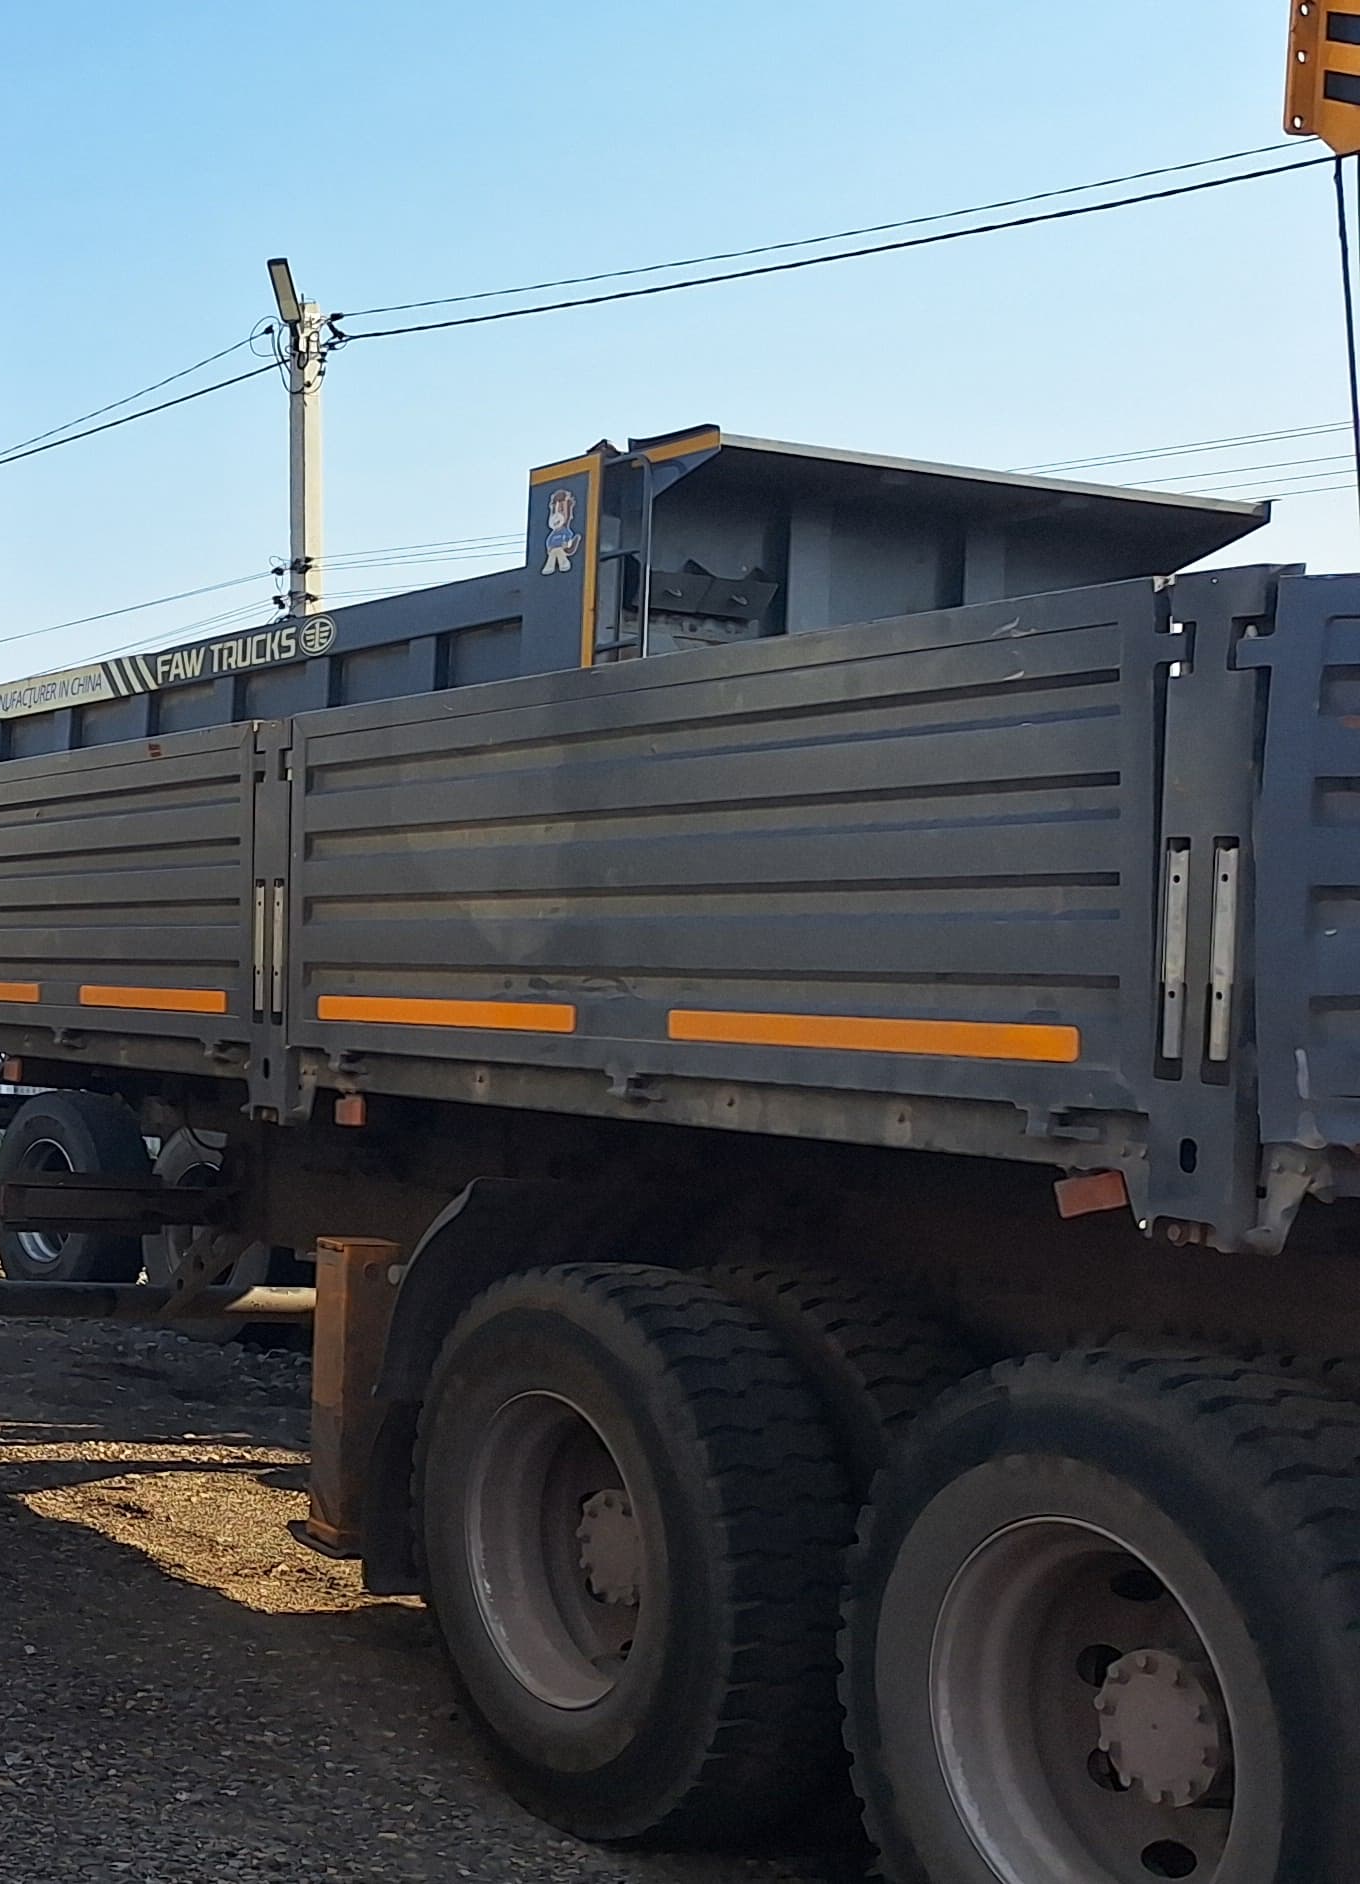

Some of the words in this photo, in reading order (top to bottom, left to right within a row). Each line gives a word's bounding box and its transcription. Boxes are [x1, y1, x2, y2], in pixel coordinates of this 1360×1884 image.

[155, 646, 205, 684] FAW
[210, 627, 296, 672] TRUCKS
[58, 680, 71, 696] IN
[71, 672, 102, 695] CHINA
